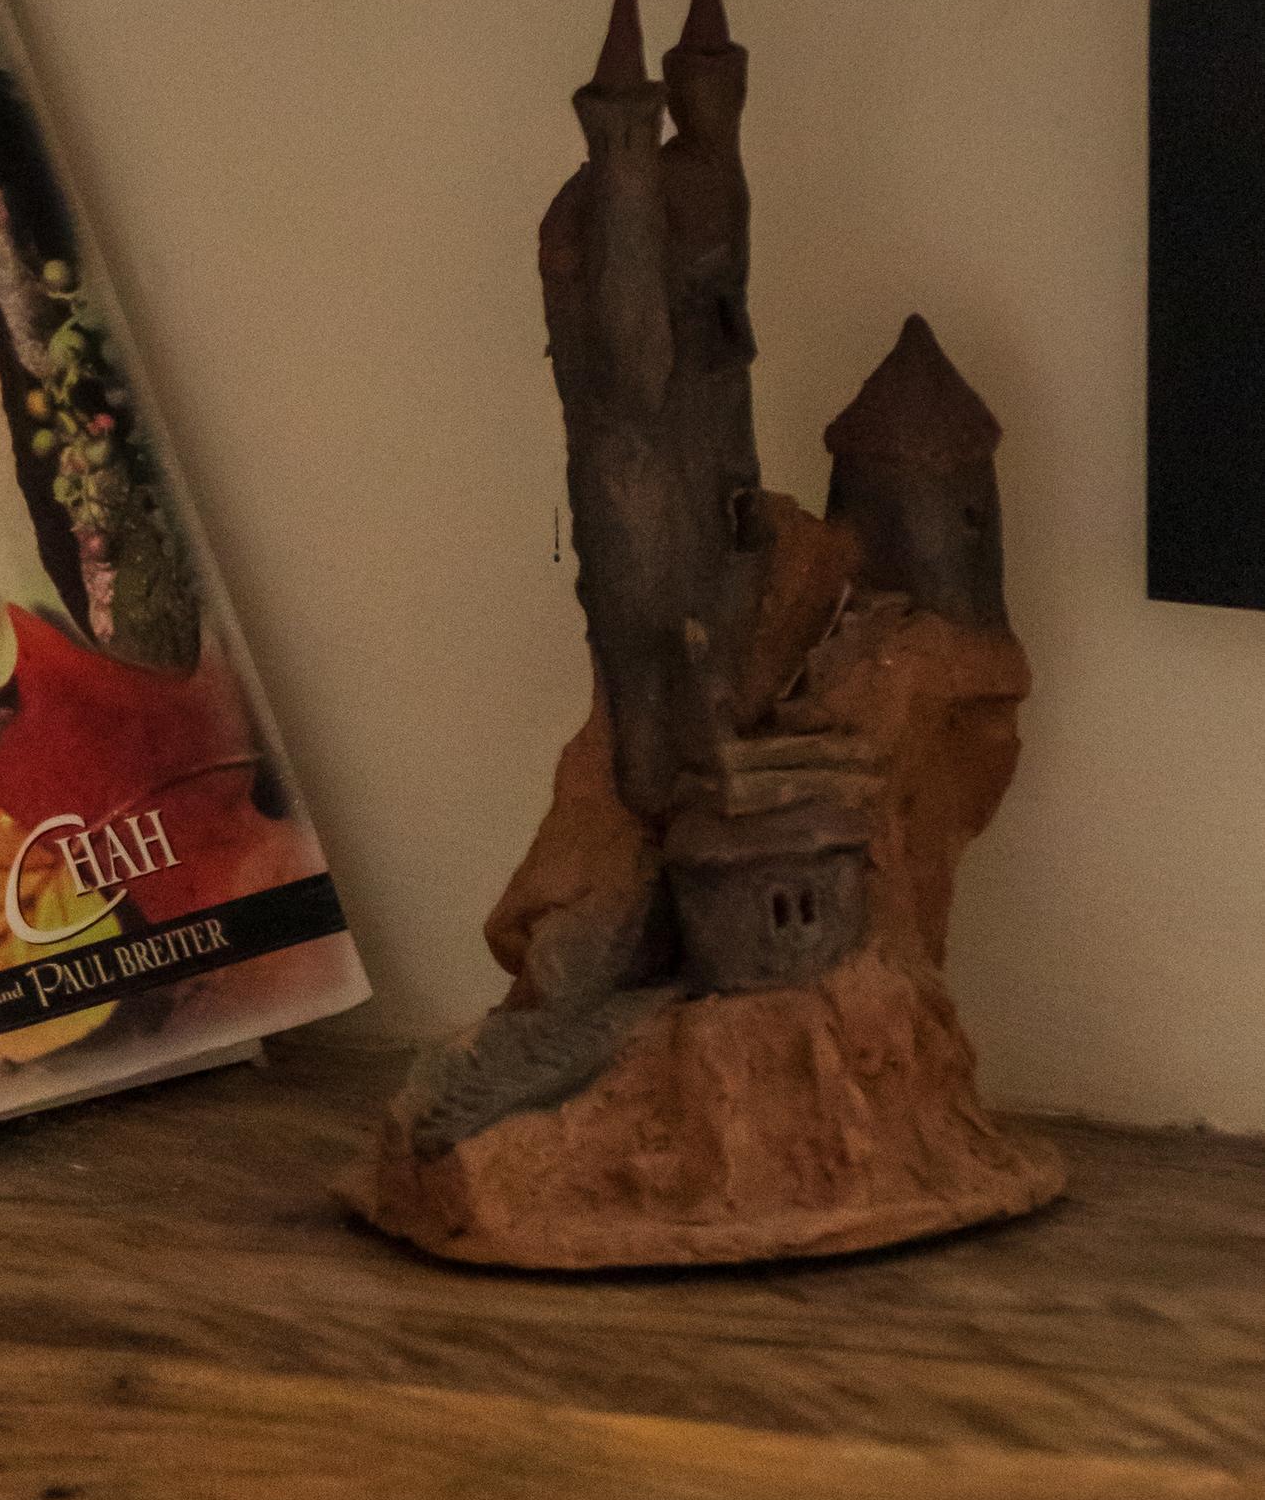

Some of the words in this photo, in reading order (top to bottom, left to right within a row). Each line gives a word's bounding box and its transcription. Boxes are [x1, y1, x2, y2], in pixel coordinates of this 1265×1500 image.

[4, 808, 184, 946] CHAH
[24, 959, 109, 1012] PAUL
[115, 916, 231, 977] BREITER
